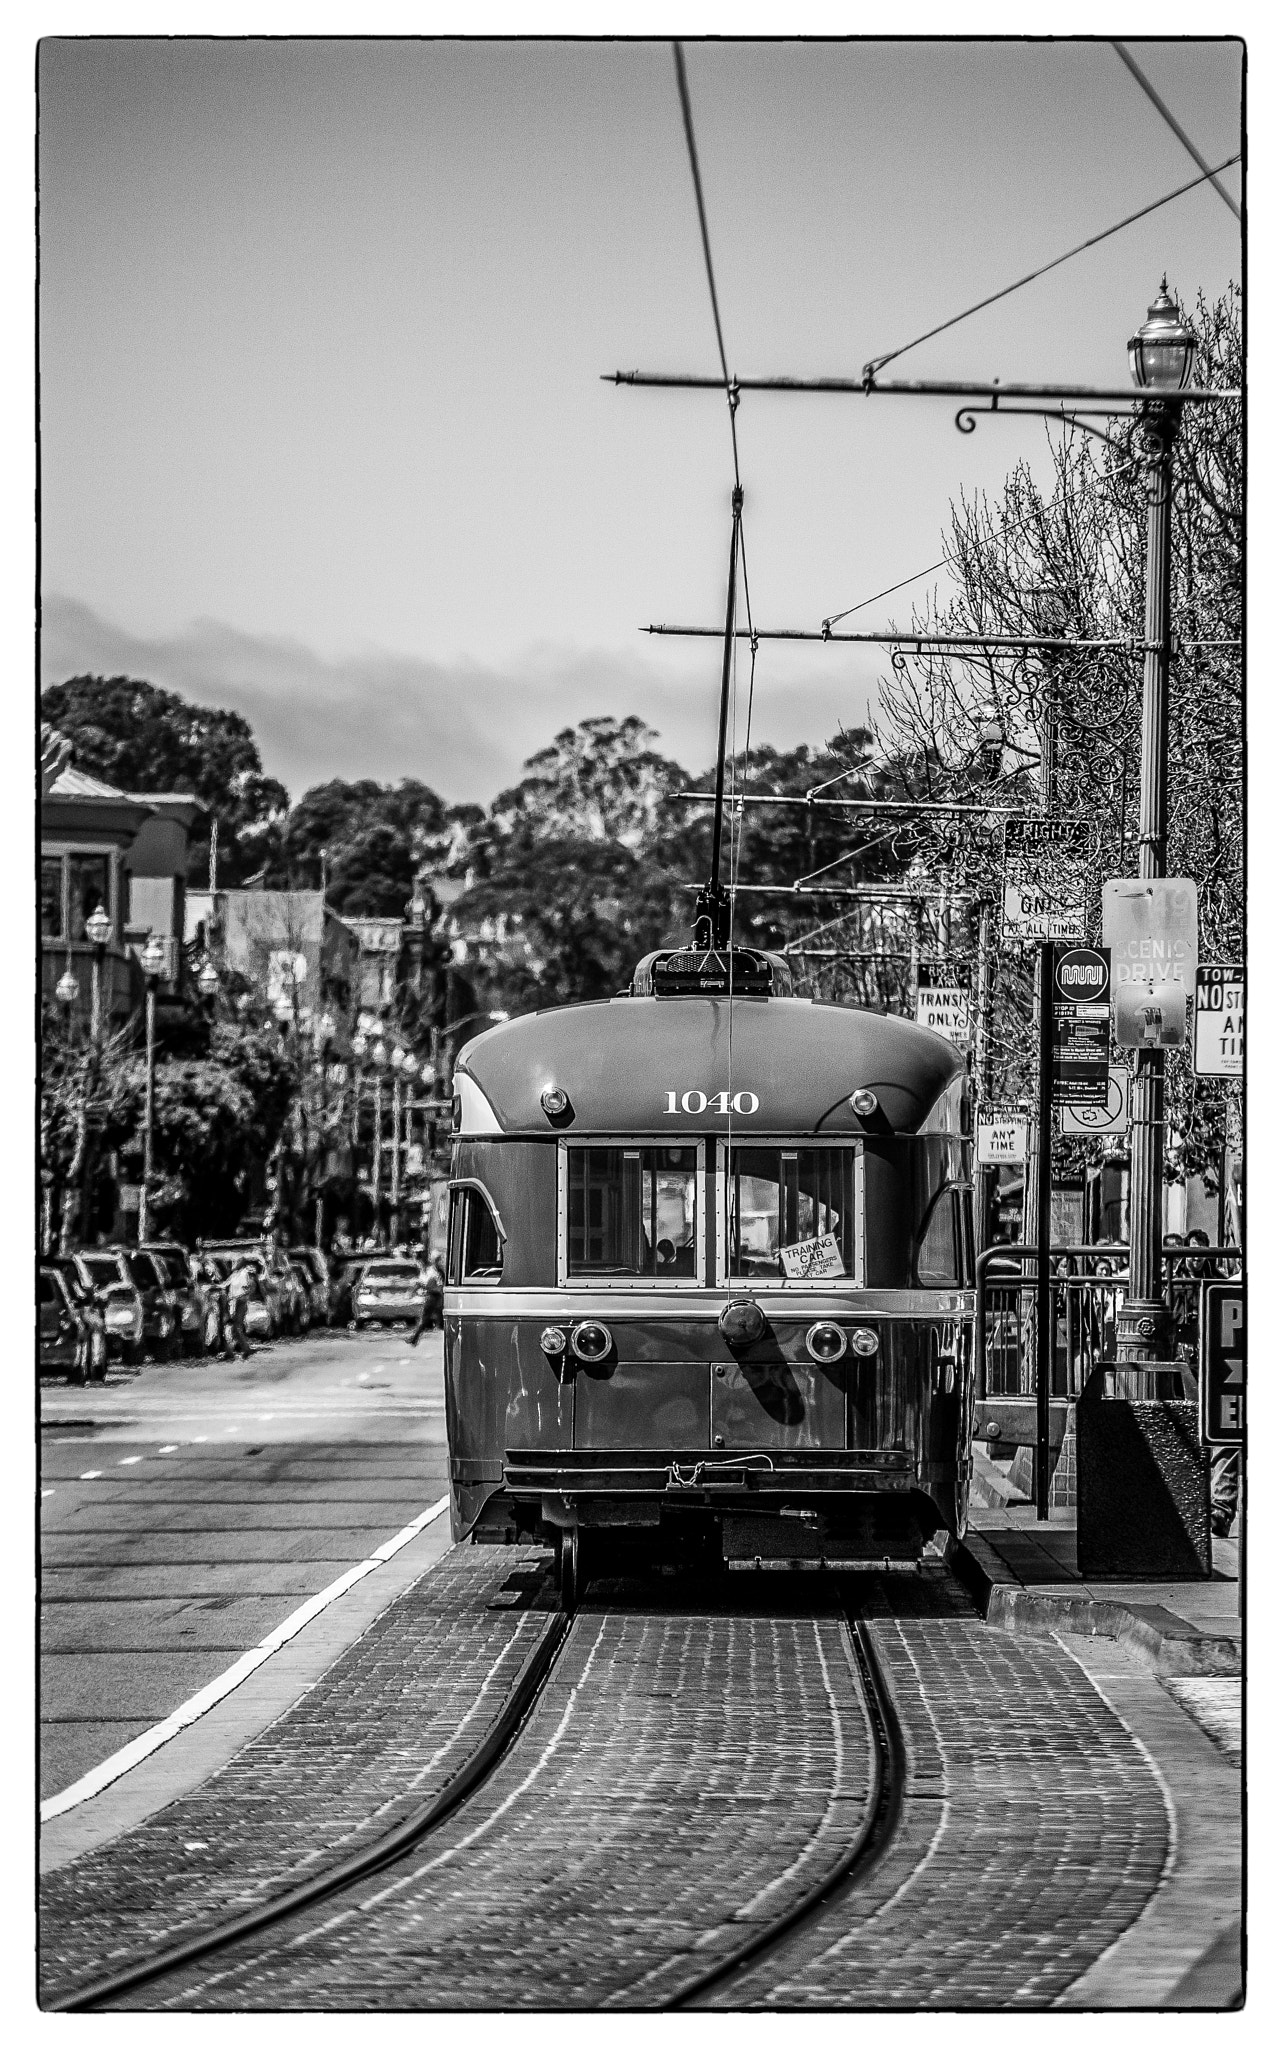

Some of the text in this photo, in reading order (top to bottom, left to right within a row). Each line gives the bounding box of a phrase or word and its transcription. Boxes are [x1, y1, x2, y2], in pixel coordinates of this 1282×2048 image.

[1026, 923, 1045, 935] ALL
[1116, 940, 1185, 959] SCENIC
[1116, 963, 1185, 982] DRIVE
[921, 993, 967, 1007] TRANSI
[1197, 984, 1244, 1010] NO ST
[928, 1012, 959, 1027] ONLY
[1219, 1038, 1244, 1056] TI
[662, 1090, 760, 1115] 1040
[978, 1112, 993, 1126] NO
[992, 1130, 1013, 1140] ANY
[990, 1141, 1015, 1151] TIME
[785, 1238, 833, 1259] TRAINING
[800, 1250, 824, 1264] CAR
